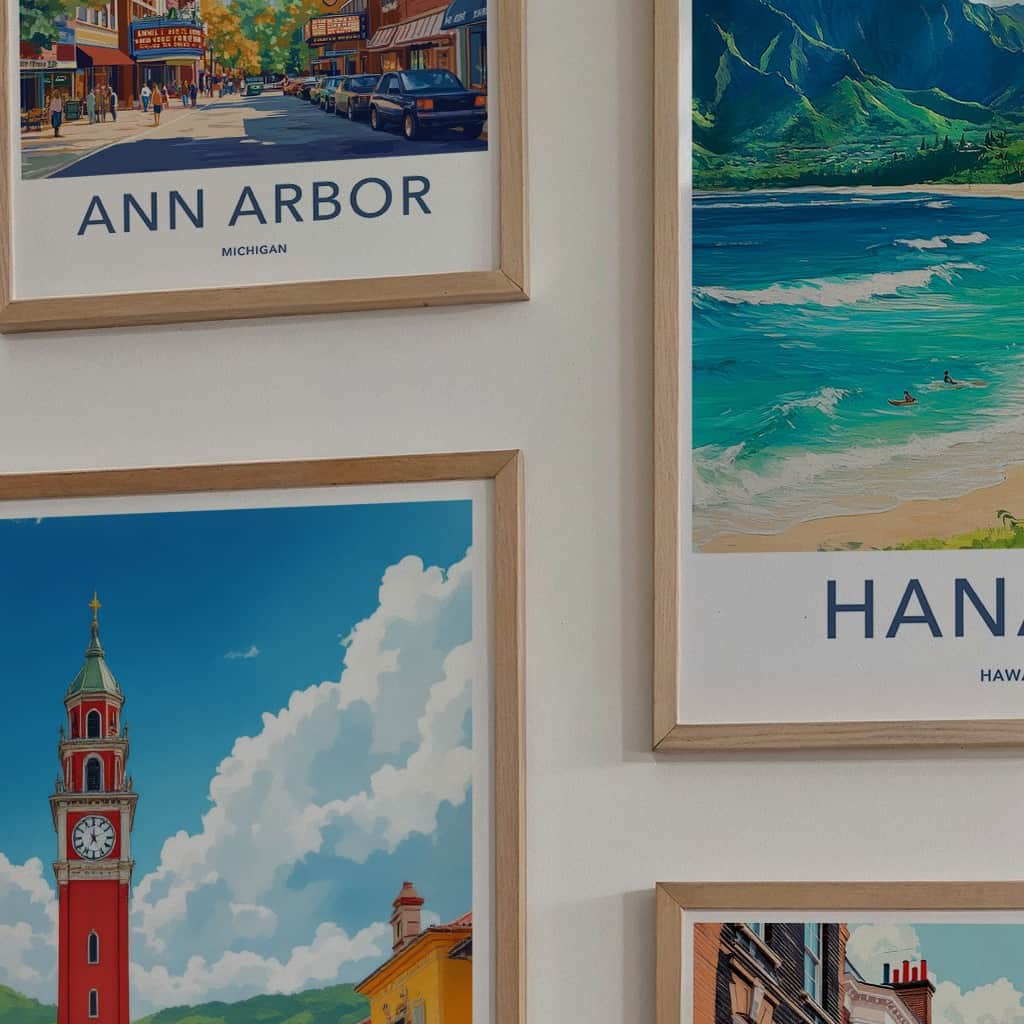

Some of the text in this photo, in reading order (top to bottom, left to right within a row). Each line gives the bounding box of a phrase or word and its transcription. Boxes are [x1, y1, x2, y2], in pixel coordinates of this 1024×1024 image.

[77, 175, 432, 236] ANN ARBOR
[221, 243, 288, 257] MICHIGAN
[826, 577, 1024, 639] HAN
